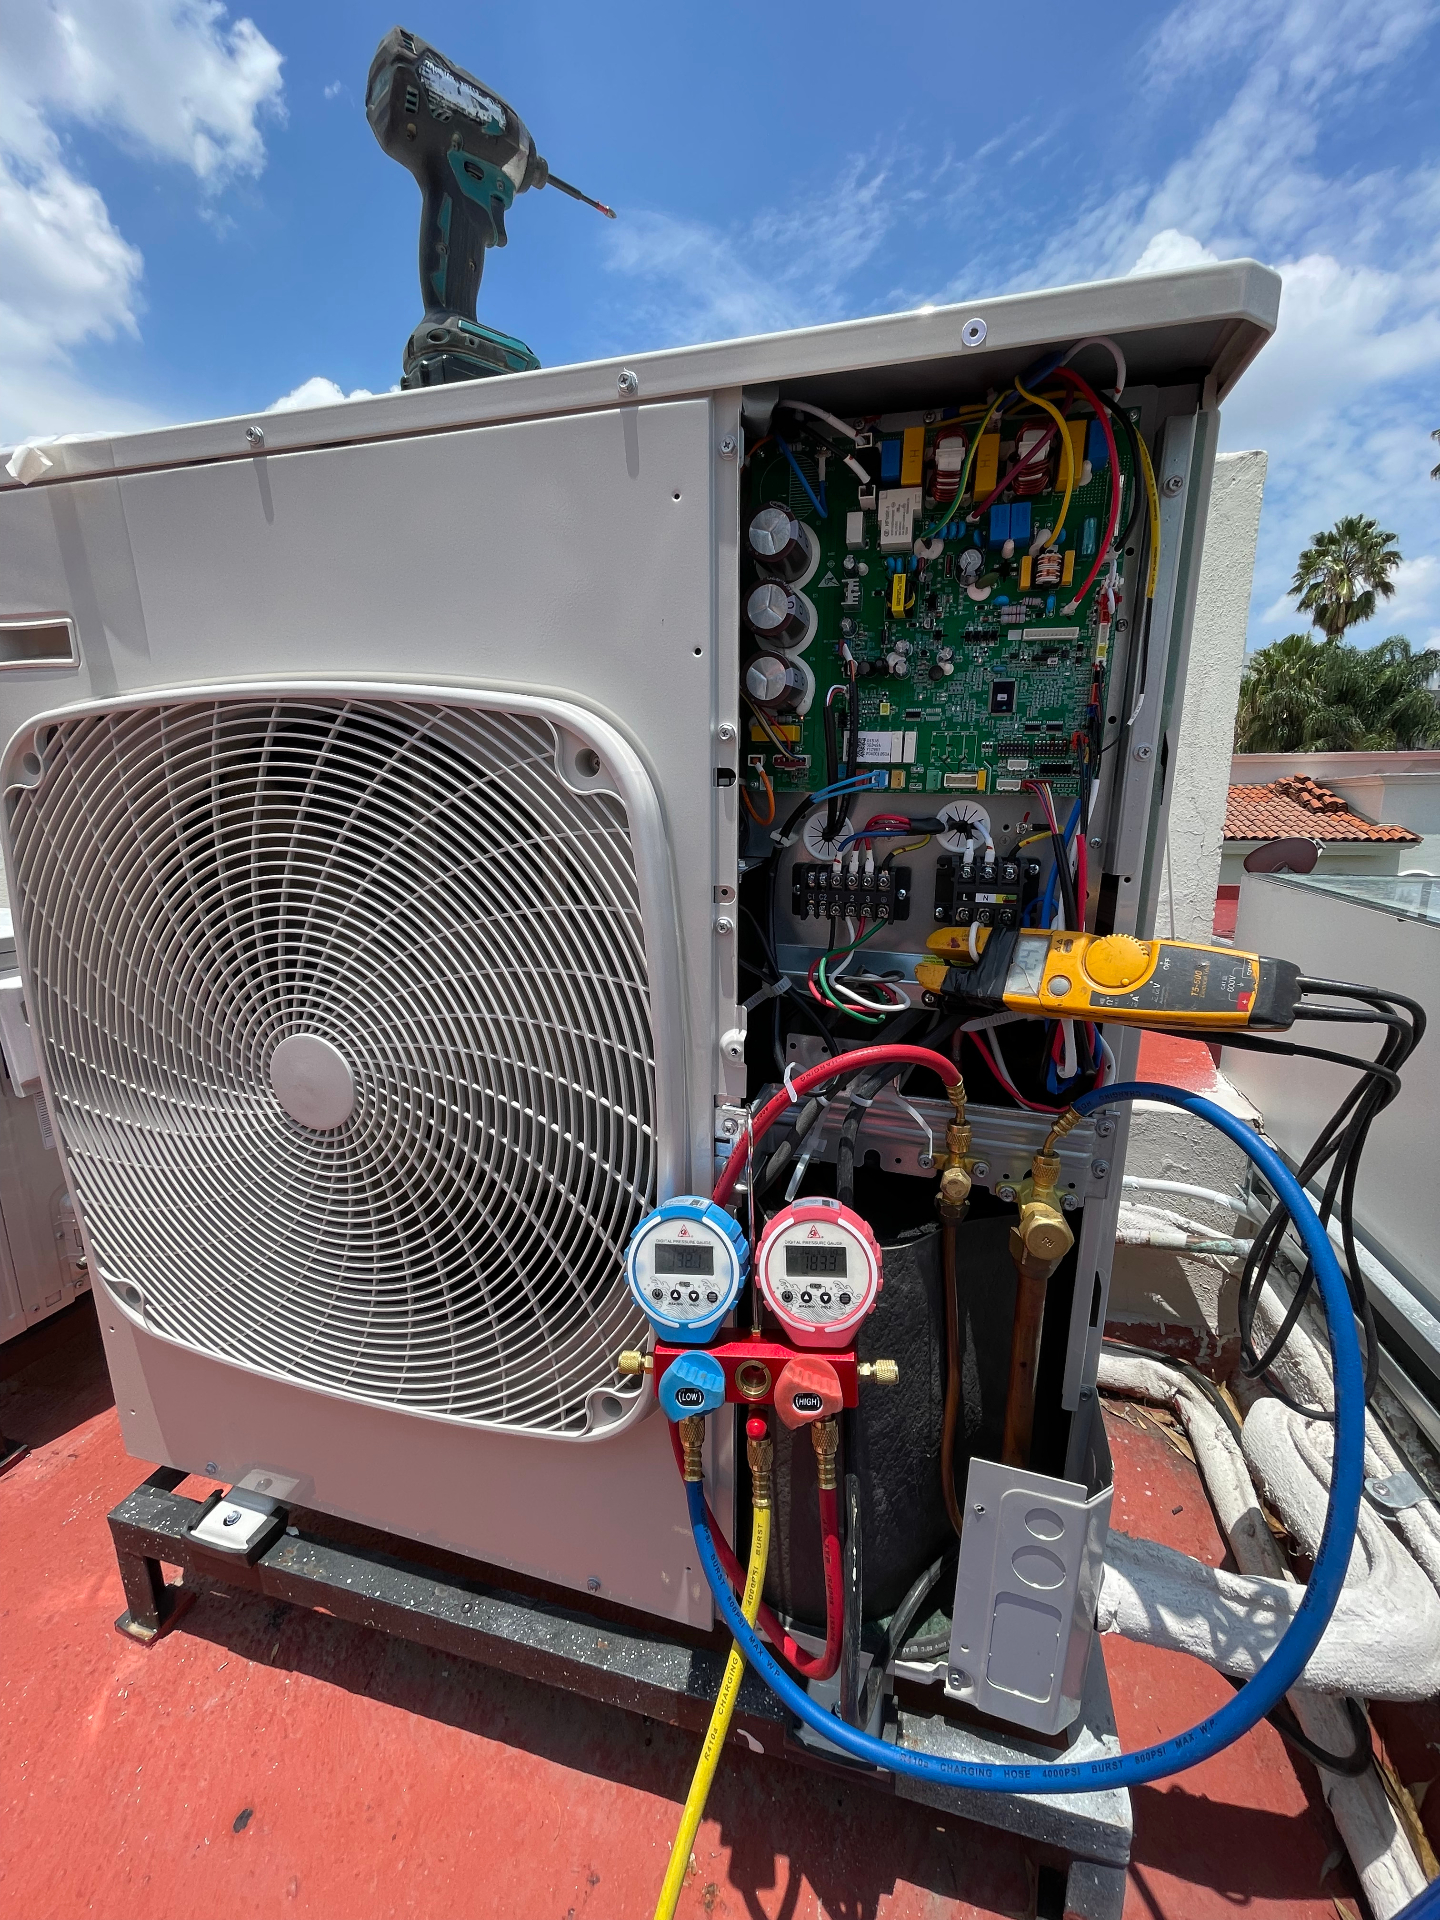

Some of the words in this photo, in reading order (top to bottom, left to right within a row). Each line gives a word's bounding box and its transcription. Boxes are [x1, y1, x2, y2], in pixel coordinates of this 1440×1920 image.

[818, 893, 827, 901] C2
[850, 894, 855, 902] 2
[962, 893, 968, 901] L
[982, 894, 989, 902] N
[1163, 956, 1171, 971] OFF
[1191, 970, 1204, 997] T5-500
[1227, 974, 1237, 993] 600V
[1098, 1090, 1142, 1100] CHARGING
[805, 1255, 837, 1271] 1833
[1317, 1503, 1335, 1567] CHARGING
[710, 1553, 726, 1587] BURST
[726, 1595, 746, 1629] 800PSI
[748, 1634, 765, 1661] MAX.
[703, 1727, 719, 1762] R410a
[717, 1656, 739, 1716] CHARGING
[746, 1565, 759, 1606] 4000PSI
[755, 1522, 764, 1557] BURST
[939, 1762, 993, 1779] CHARGING
[1003, 1766, 1031, 1779] HOSE
[1042, 1766, 1081, 1779] 4000PSI
[1091, 1759, 1124, 1775] BURST
[1134, 1746, 1167, 1766] 800PSI
[1174, 1732, 1199, 1750] MAX.
